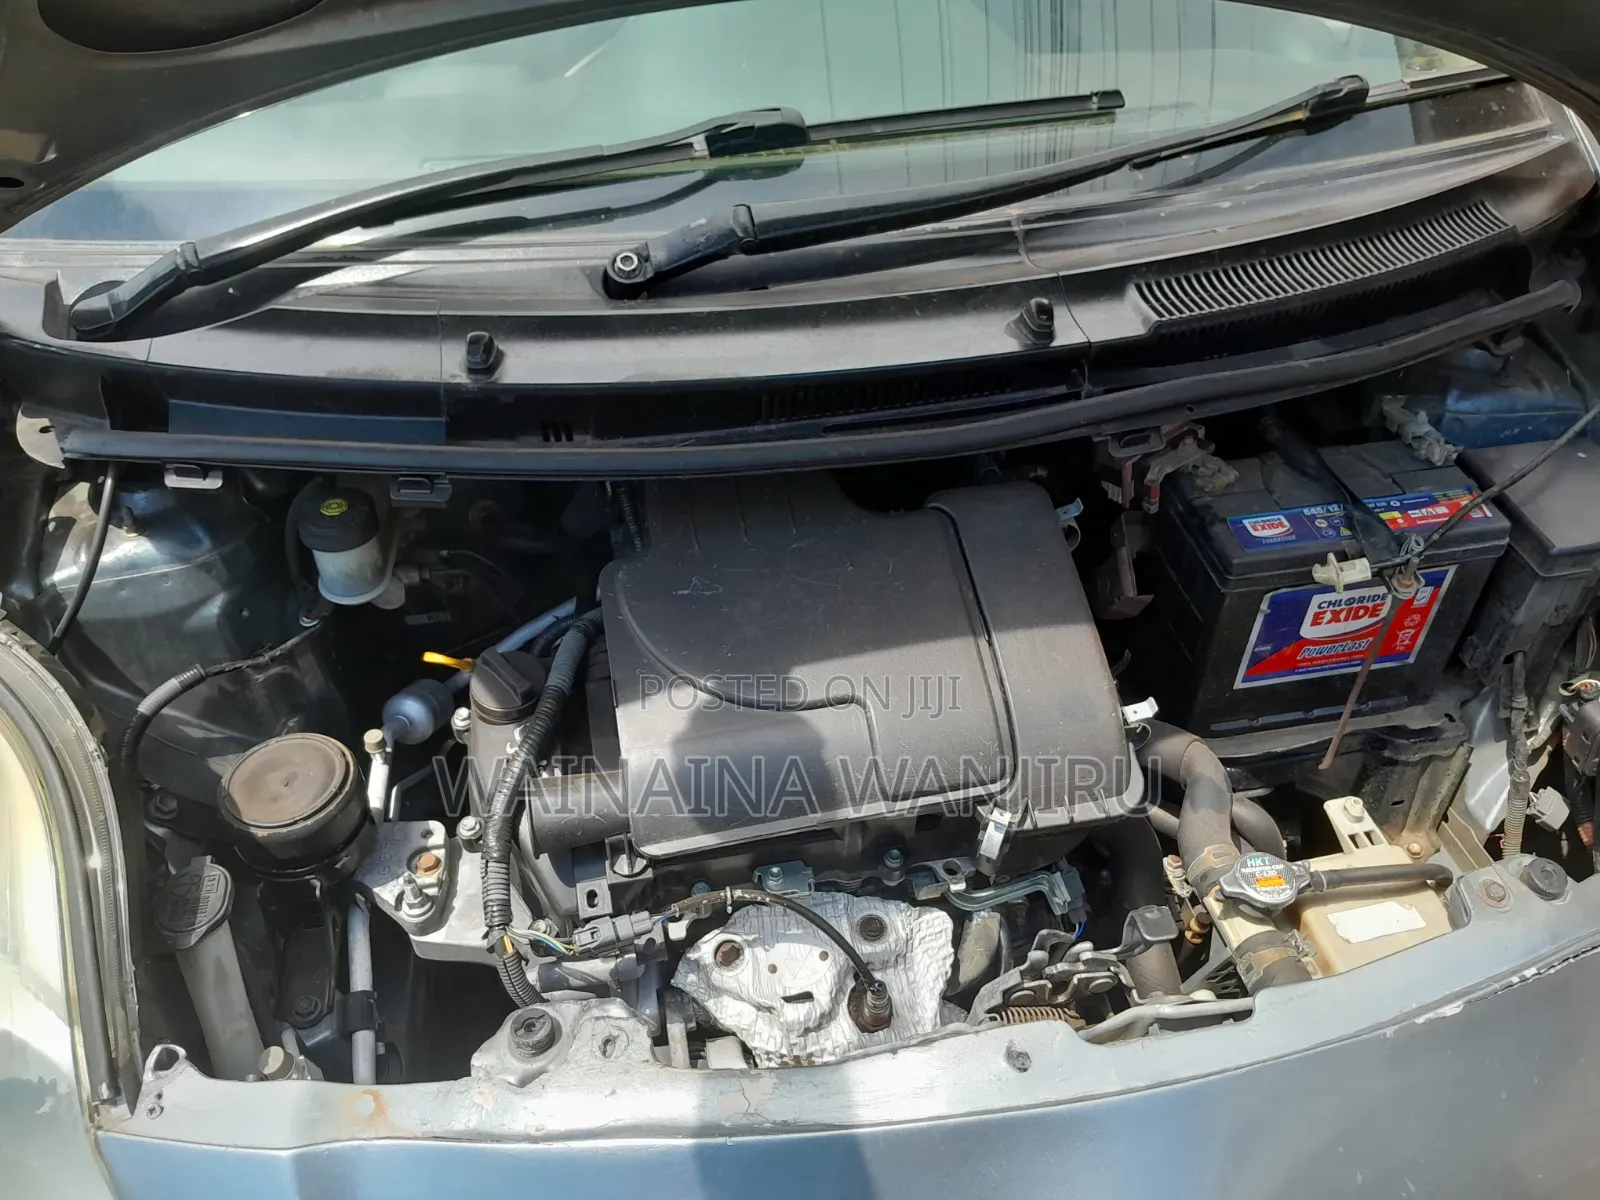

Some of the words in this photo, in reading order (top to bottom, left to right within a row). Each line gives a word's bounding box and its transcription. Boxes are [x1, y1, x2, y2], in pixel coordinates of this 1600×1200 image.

[1250, 521, 1288, 532] EXIDE
[1317, 592, 1389, 610] CHLORIDE
[1310, 601, 1386, 627] EXIDE
[1247, 856, 1270, 867] HKT
